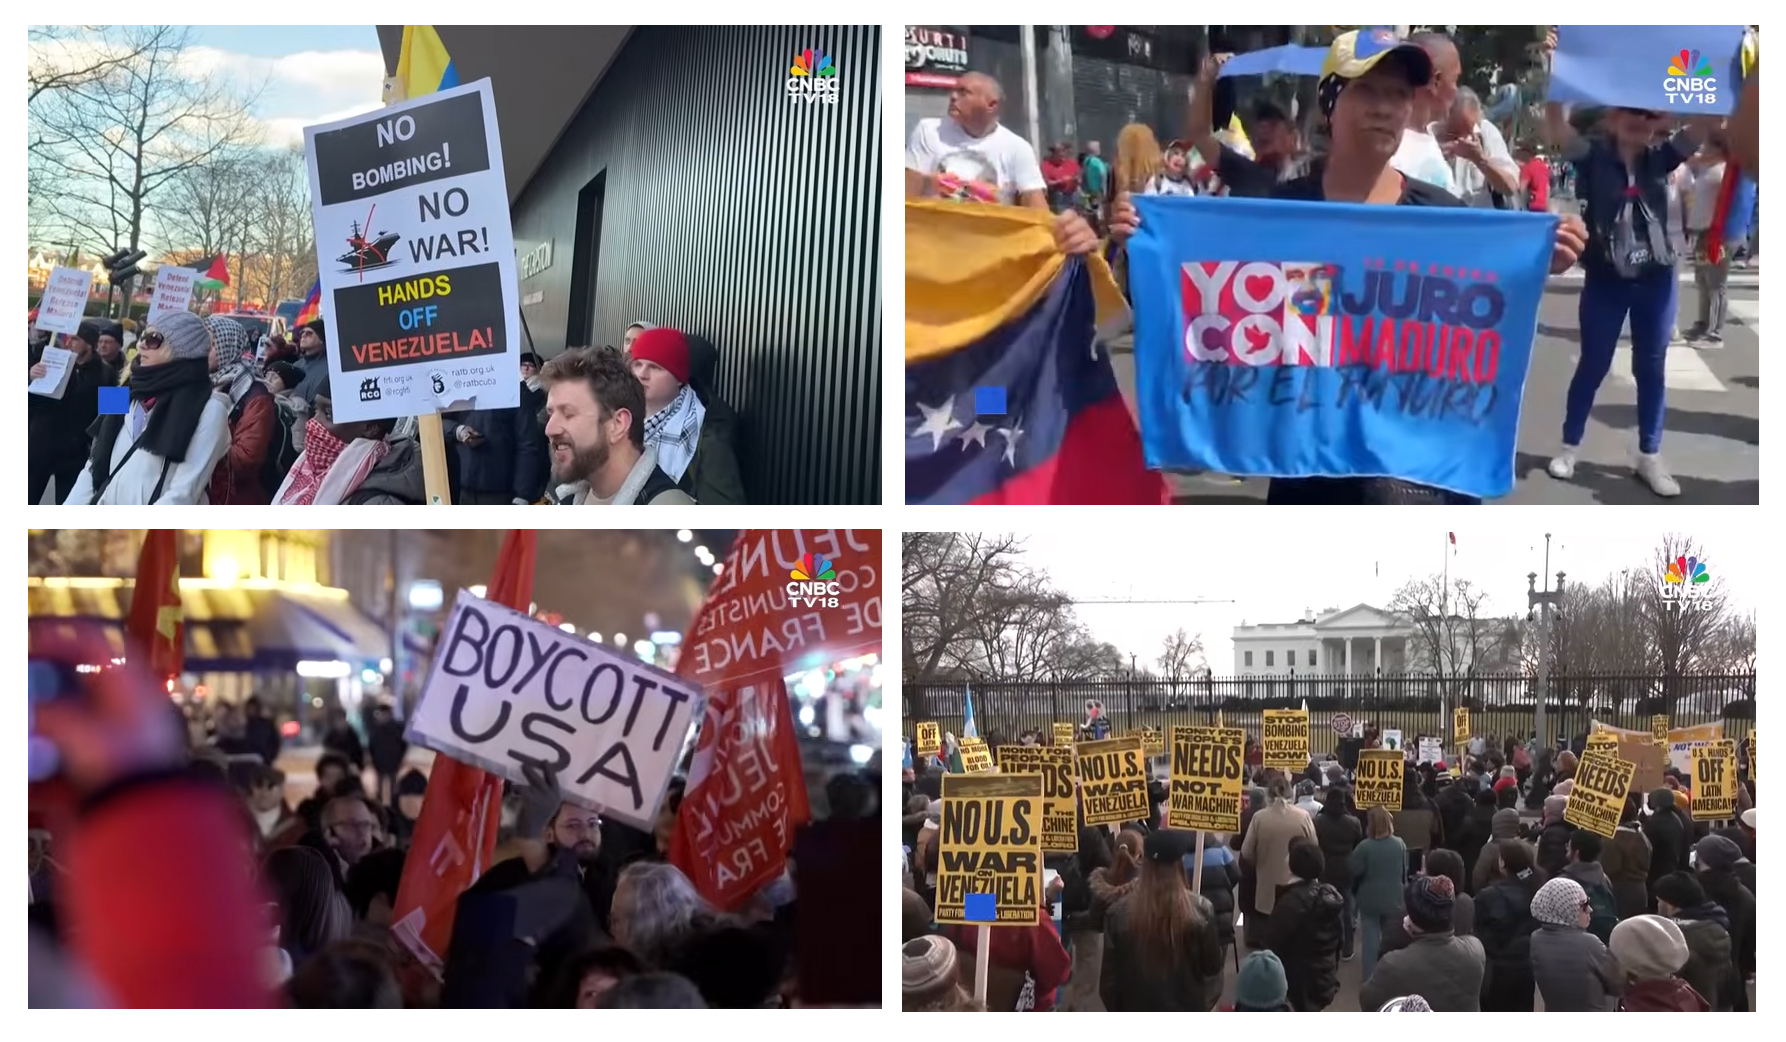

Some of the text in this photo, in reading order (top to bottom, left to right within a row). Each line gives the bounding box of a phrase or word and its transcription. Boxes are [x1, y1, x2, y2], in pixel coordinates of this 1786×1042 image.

[376, 115, 416, 148] NO
[352, 142, 451, 190] BOMBING!
[418, 187, 469, 223] NO
[409, 227, 489, 264] WAR!
[378, 274, 451, 306] HANDS
[1181, 261, 1505, 330] YO JURO
[399, 305, 437, 331] OFF
[352, 327, 494, 365] VENEZUELA!
[1184, 314, 1502, 386] CON MADURO
[451, 365, 495, 377] ratb.org.uk
[454, 377, 497, 388] @ratbcuba
[361, 390, 380, 399] RCG
[442, 605, 689, 752] BOYCOTT
[1265, 716, 1308, 724] STOP
[922, 728, 936, 740] OFF
[1175, 734, 1242, 745] PEOPLE'S
[1265, 724, 1307, 738] BOMBING
[450, 684, 643, 811] USA
[1265, 740, 1308, 750] VENEZUELA
[1587, 742, 1618, 750] STOP
[1692, 748, 1728, 758] U.S. HANDS
[1000, 754, 1072, 764] PEOPLE'S
[1080, 755, 1106, 782] NO
[1107, 751, 1144, 779] U.S.
[1174, 743, 1241, 780] NEEDS
[1615, 759, 1634, 768] FOR
[1358, 760, 1402, 779] NO U.S.
[1698, 758, 1724, 783] OFF
[1084, 780, 1146, 797] WAR
[1172, 780, 1222, 796] NOT
[1358, 780, 1401, 790] WAR
[1576, 762, 1629, 798] NEEDS
[1356, 790, 1401, 803] VENEZUELA
[1572, 788, 1608, 806] NOT
[1702, 785, 1722, 798] LATIN
[1085, 792, 1147, 814] VENEZUELA
[1172, 794, 1194, 810] WAR
[1195, 796, 1238, 815] MACHINE
[1569, 798, 1586, 812] WAR
[1586, 804, 1619, 824] MACHINE
[1692, 798, 1732, 812] AMERICA!
[943, 800, 1037, 846] NO U.S.
[942, 851, 1037, 873] WAR
[940, 875, 1036, 905] VENEZUELA
[938, 908, 954, 918] PARTY
